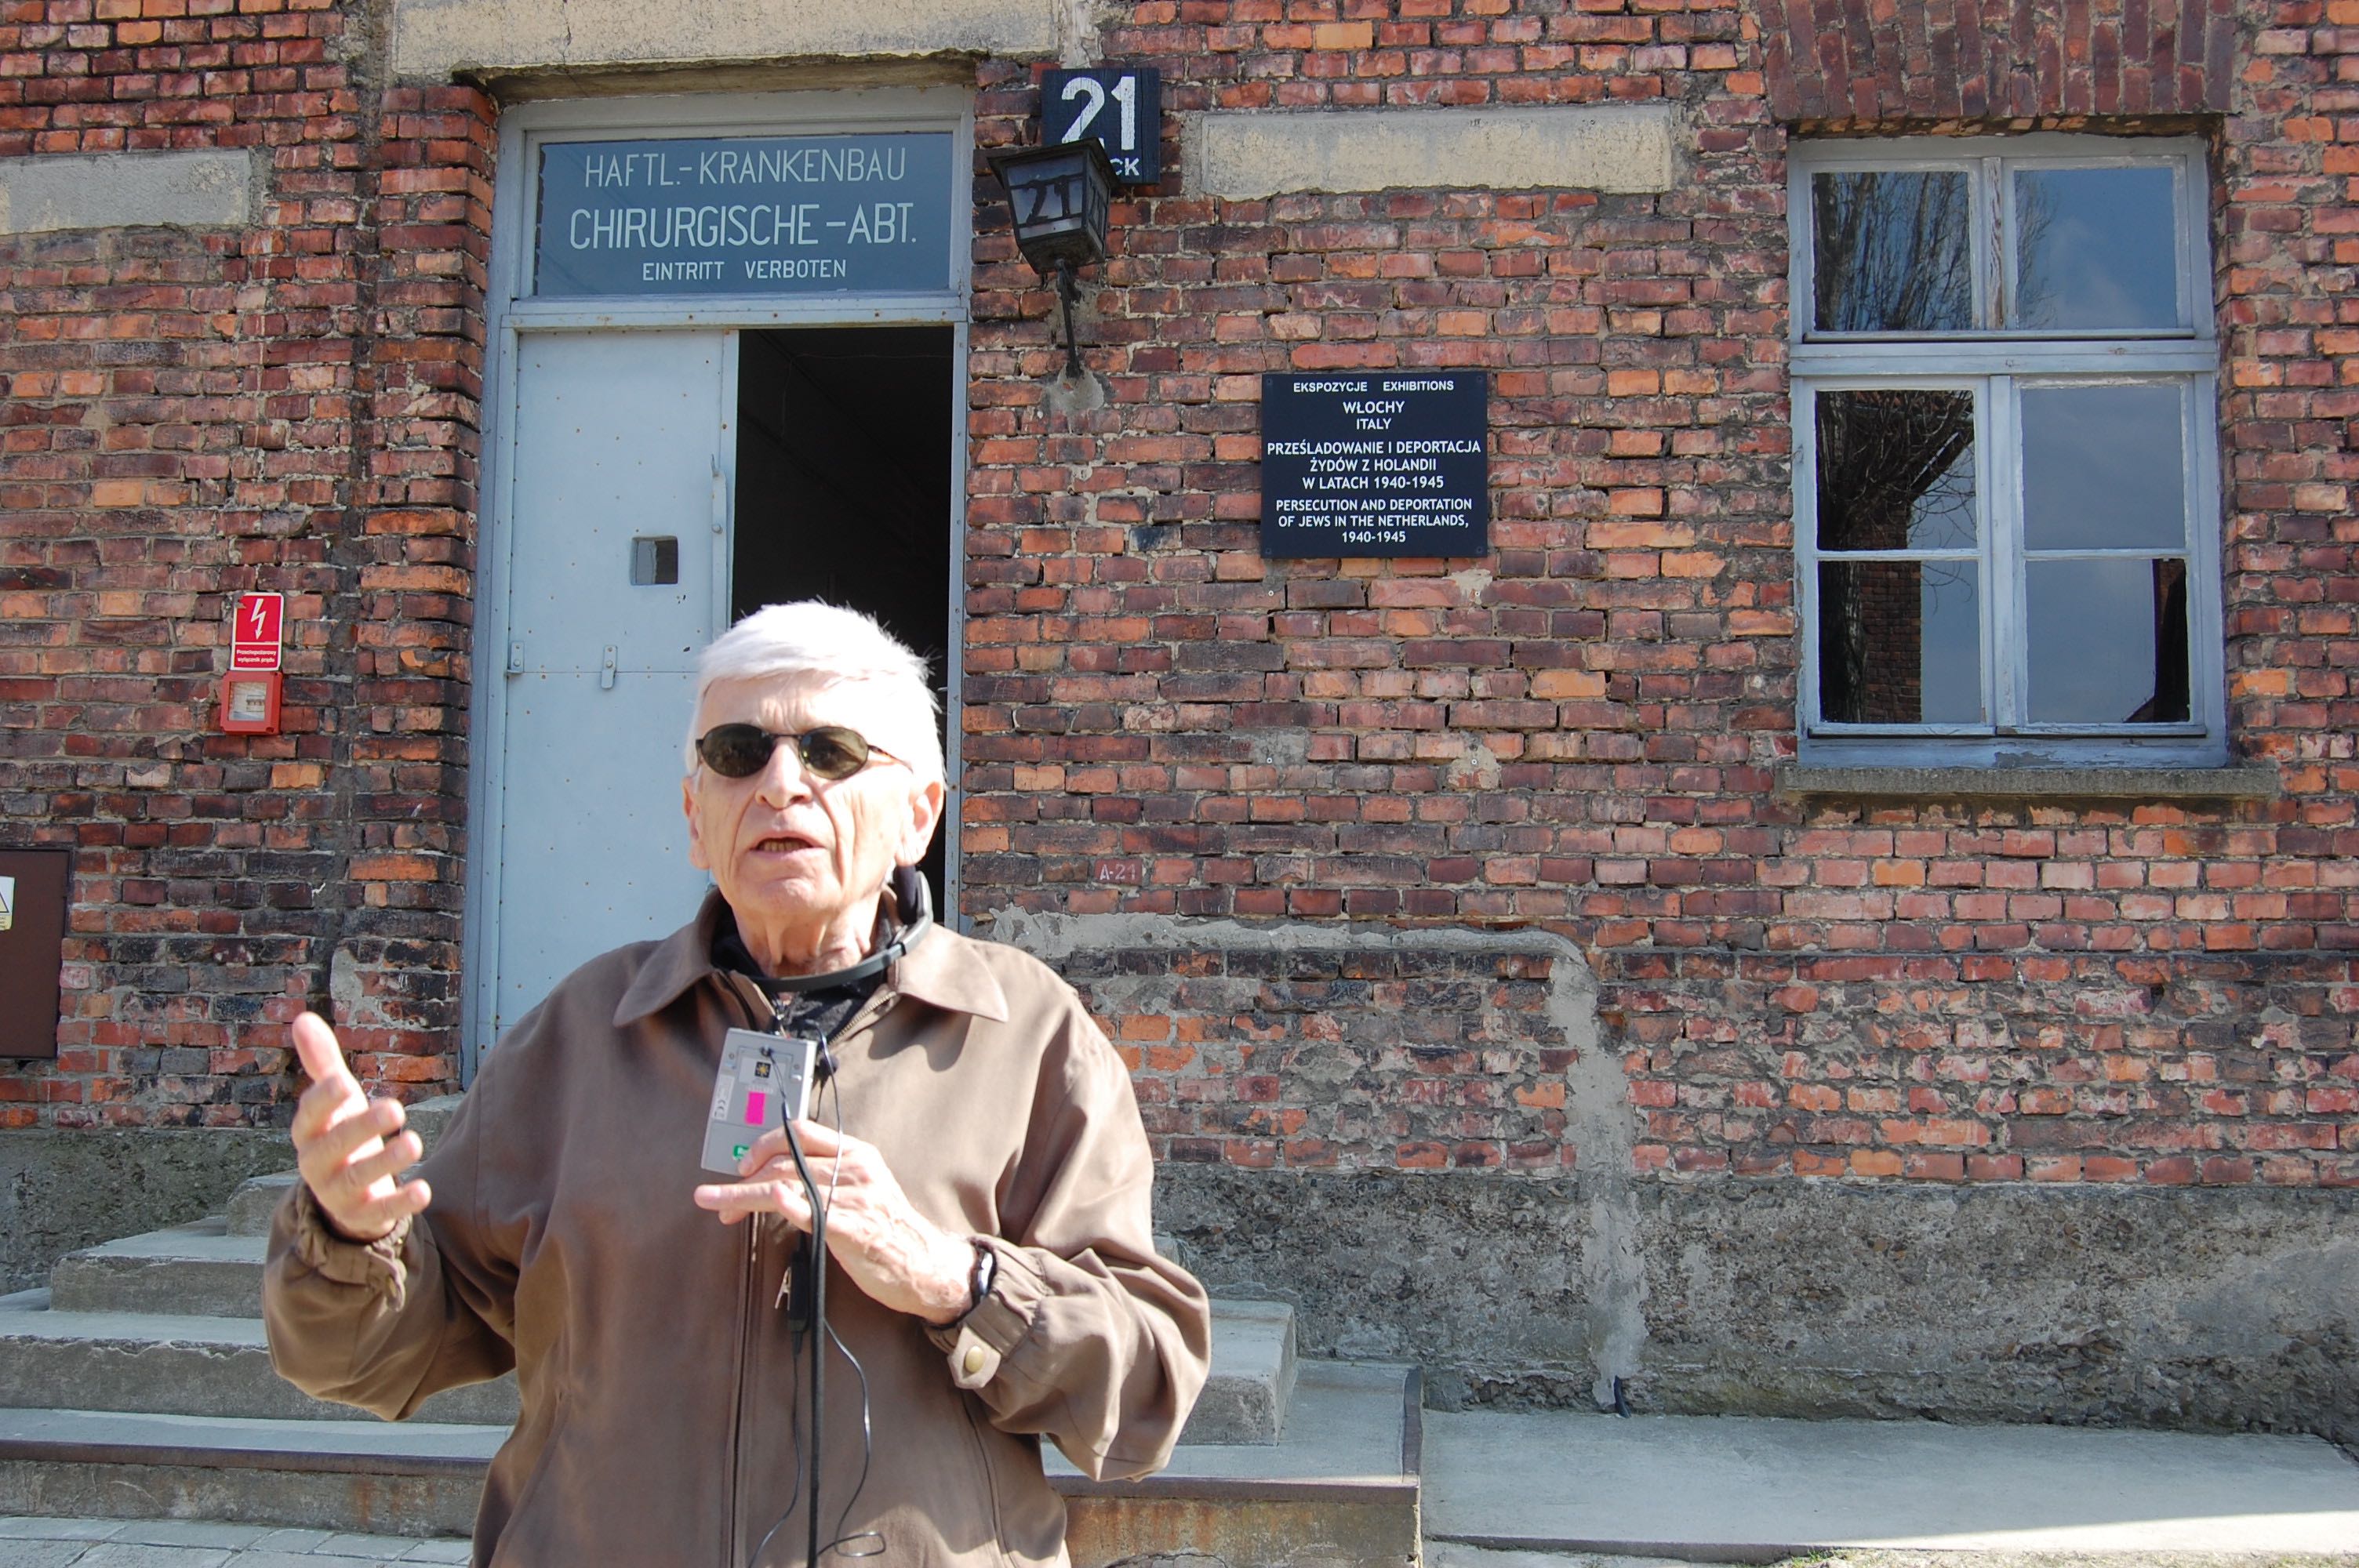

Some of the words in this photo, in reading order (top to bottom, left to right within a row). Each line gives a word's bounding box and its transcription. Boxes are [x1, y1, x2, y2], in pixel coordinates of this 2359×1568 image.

[1061, 76, 1136, 150] 21
[1110, 158, 1140, 176] CK
[1026, 175, 1070, 226] 21
[642, 261, 725, 281] EINTRITT
[744, 259, 846, 279] VERBOTEN
[1293, 382, 1368, 393] EKSPOZYCJE
[1383, 380, 1455, 392] EXHIBITIONS
[1342, 401, 1405, 415] WŁOCHY
[1356, 417, 1392, 430] ITALY
[1267, 439, 1384, 456] PRZEŚLADOWANIE
[1388, 441, 1392, 454] I
[1396, 440, 1481, 454] DEPORTACJA
[1310, 456, 1358, 472] ŻYDÓW
[1361, 459, 1370, 472] Z
[1374, 458, 1437, 472] HOLANDII
[1302, 477, 1316, 490] W
[1319, 476, 1369, 490] LATACH
[1373, 475, 1444, 489] 1940-1945
[1276, 499, 1358, 512] PERSECUTION
[1361, 499, 1387, 511] AND
[1390, 498, 1472, 511] DEPORTATION
[1278, 515, 1296, 528] OF
[1298, 515, 1331, 528] JEWS
[1334, 515, 1347, 527] IN
[1349, 514, 1375, 527] THE
[1378, 514, 1469, 528] NETHERLANDS,
[1342, 531, 1406, 543] 1940-1945
